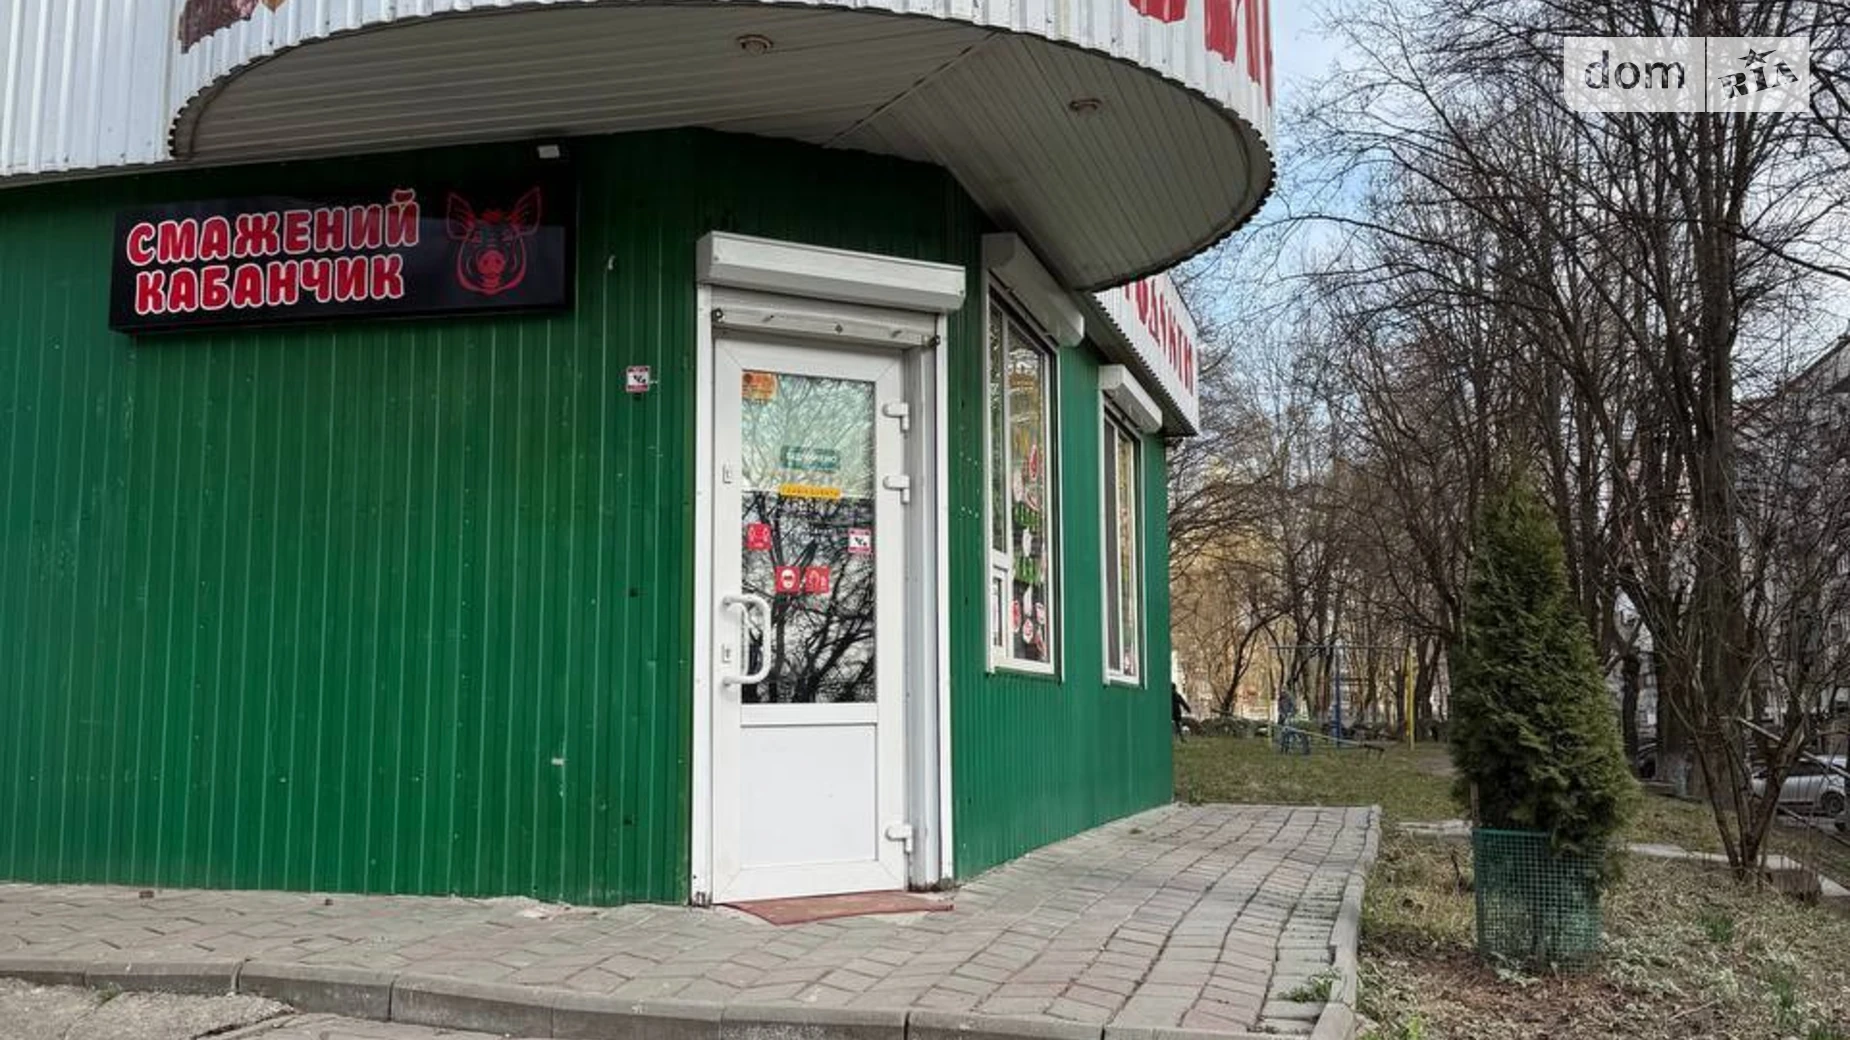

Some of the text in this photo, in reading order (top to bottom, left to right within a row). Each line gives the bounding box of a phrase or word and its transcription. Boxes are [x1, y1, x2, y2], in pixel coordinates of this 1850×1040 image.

[127, 188, 419, 266] СМАЖЕНИЙ
[135, 254, 404, 315] КАБАНЧИК
[1125, 279, 1194, 397] ОДУКТИ
